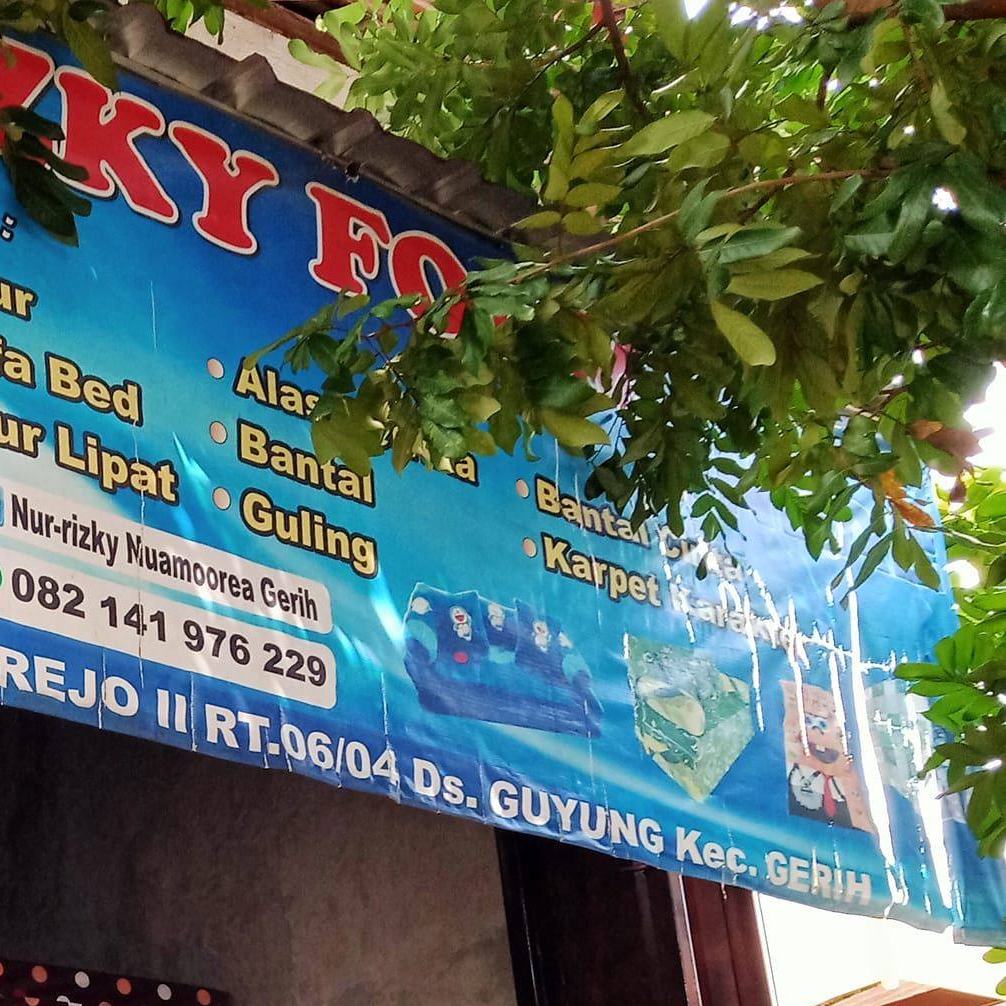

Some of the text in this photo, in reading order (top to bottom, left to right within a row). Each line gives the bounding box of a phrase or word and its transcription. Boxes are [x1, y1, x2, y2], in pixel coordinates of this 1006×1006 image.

[45, 352, 143, 425] Bed
[54, 422, 179, 503] Lipat
[238, 420, 375, 507] Bantal
[241, 490, 379, 578] Guling
[535, 474, 650, 549] Bantal
[11, 494, 319, 622] Nur-rizky Nuamoorea Gerih
[542, 533, 662, 607] Karpet
[12, 567, 327, 687] 082 141 976 229
[205, 703, 400, 786] RT.06/04
[412, 757, 478, 808] Ds.
[489, 780, 663, 855] GUYUNG
[675, 828, 757, 877] Kec.
[767, 851, 871, 906] GERIH
